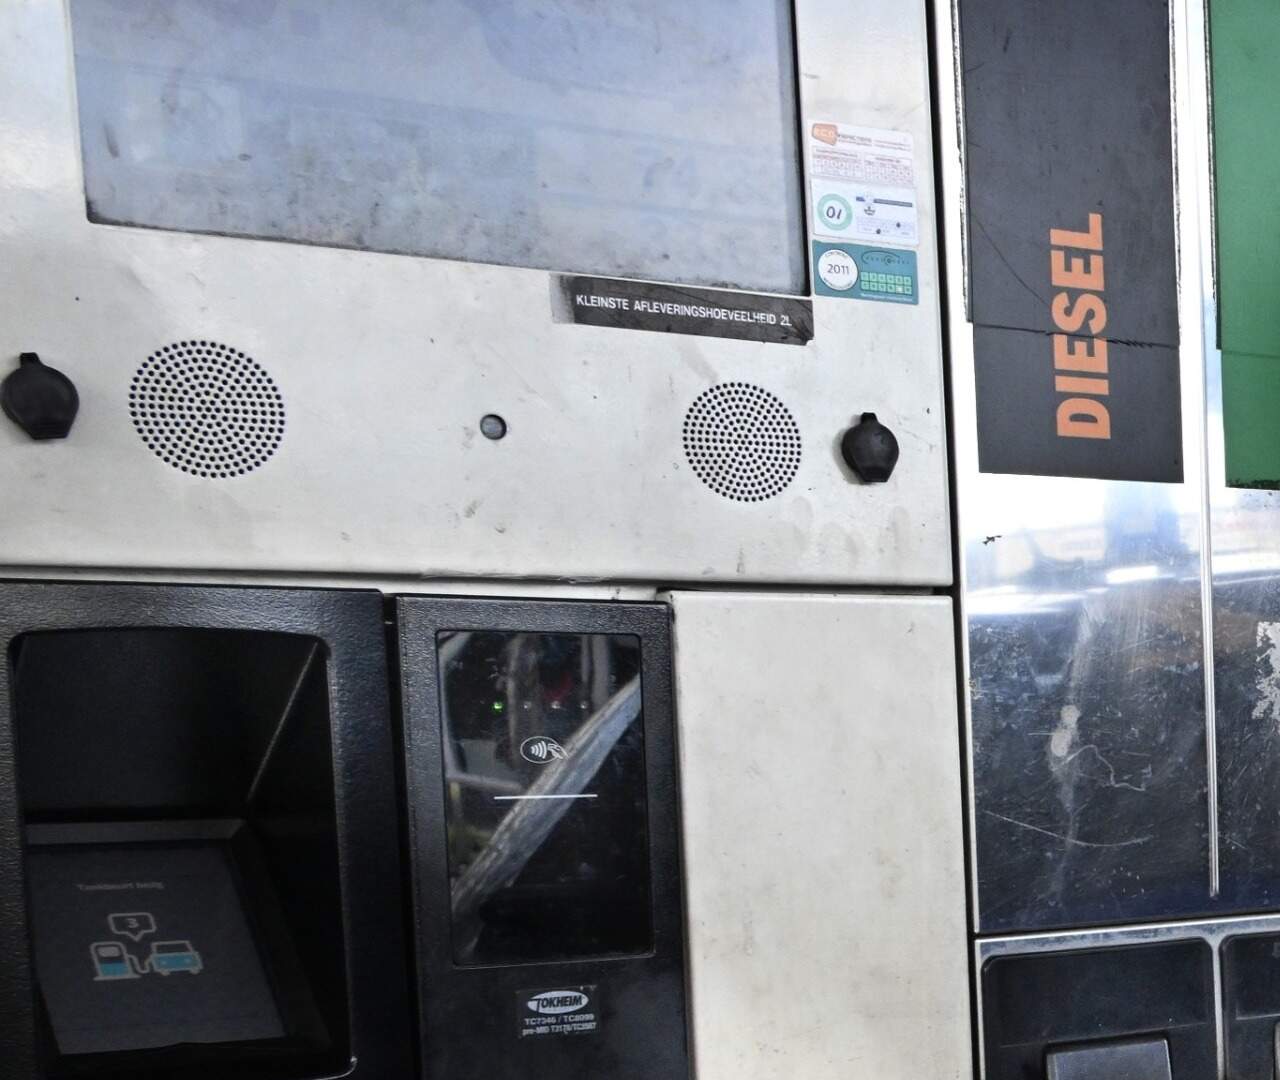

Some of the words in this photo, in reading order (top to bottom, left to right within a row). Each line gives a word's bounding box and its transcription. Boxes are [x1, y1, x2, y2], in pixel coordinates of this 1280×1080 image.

[827, 263, 850, 275] 2011
[576, 294, 630, 311] KLEINSTE
[634, 302, 777, 325] AFLEVERINGSHOEVEELHEID
[780, 313, 793, 327] 2L
[1050, 213, 1111, 439] DIESEL
[125, 917, 139, 929] 3
[531, 994, 582, 1012] TOKHEIM
